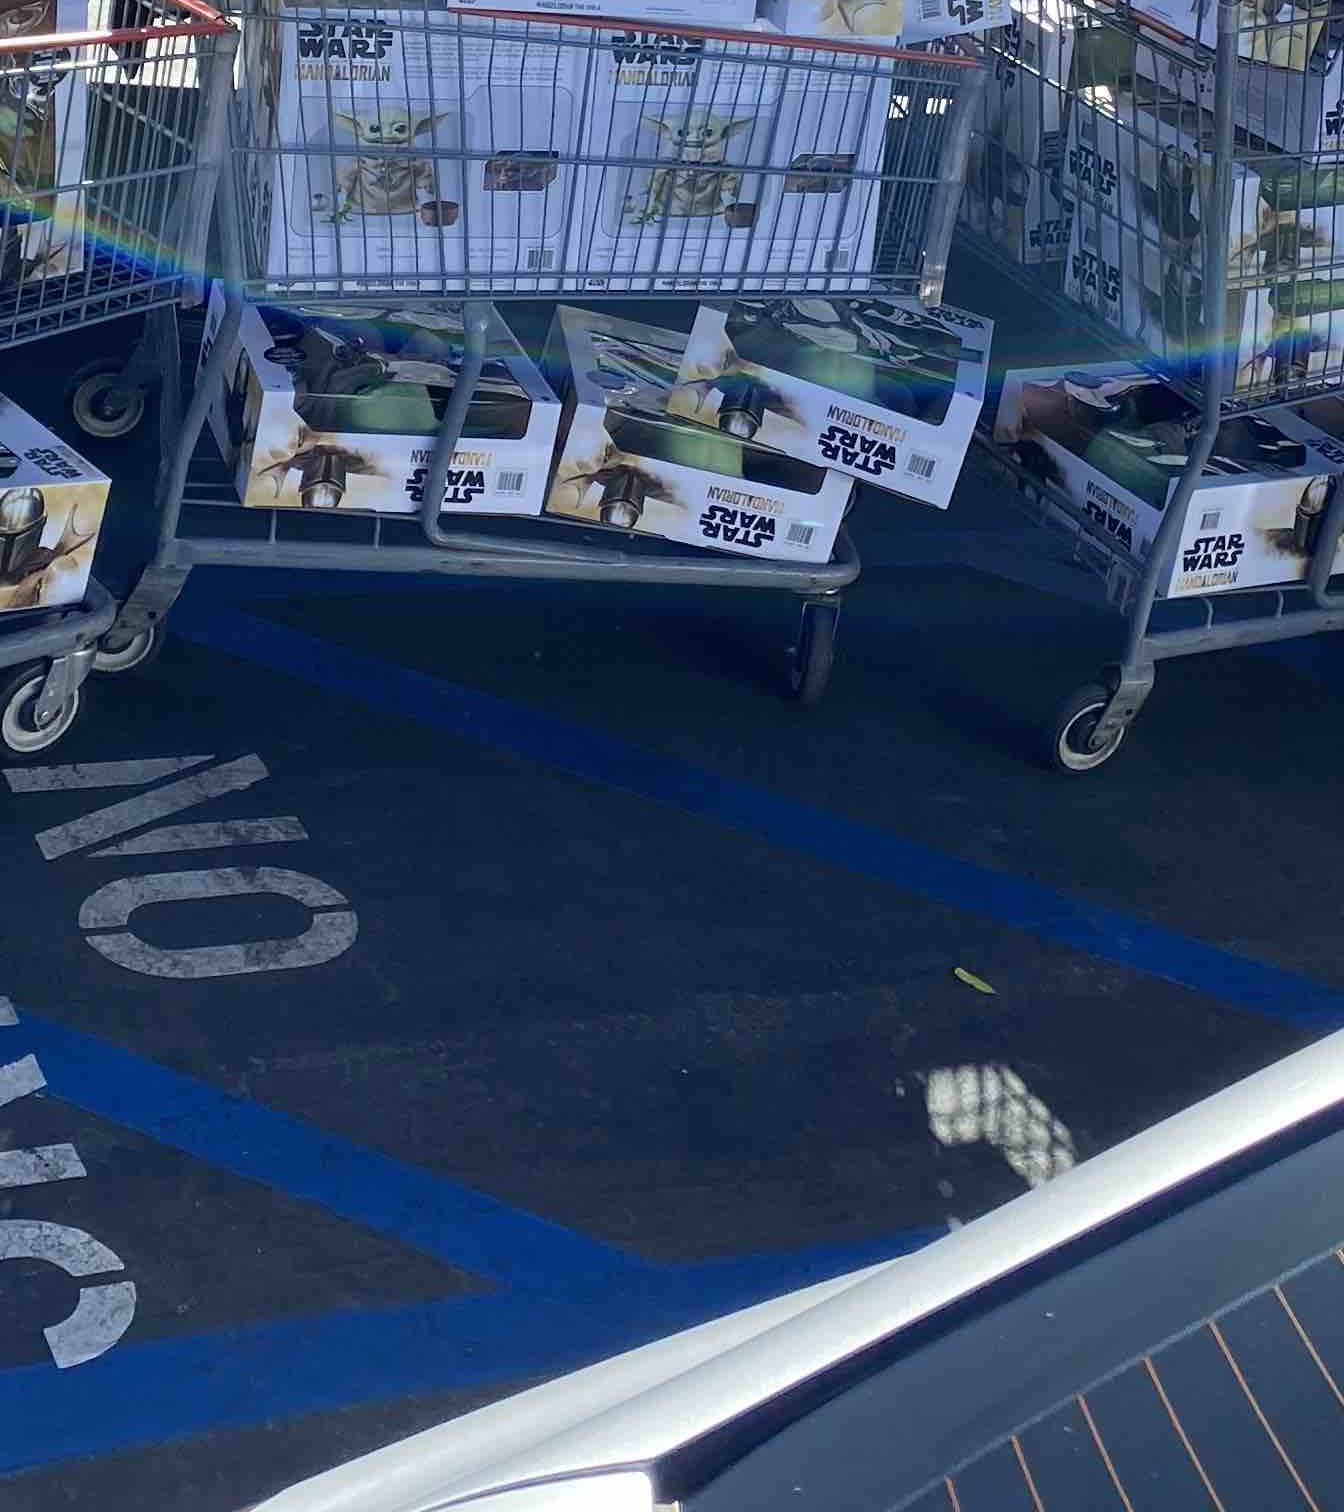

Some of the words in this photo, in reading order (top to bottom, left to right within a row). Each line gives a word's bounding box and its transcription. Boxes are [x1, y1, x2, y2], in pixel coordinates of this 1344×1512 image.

[297, 38, 393, 59] WARS
[818, 440, 895, 475] STAR
[820, 426, 896, 464] WARS
[699, 519, 775, 548] STAR
[702, 505, 776, 535] WARS
[1184, 533, 1245, 556] STAR
[1183, 550, 1244, 573] WARS
[2, 753, 360, 979] NO
